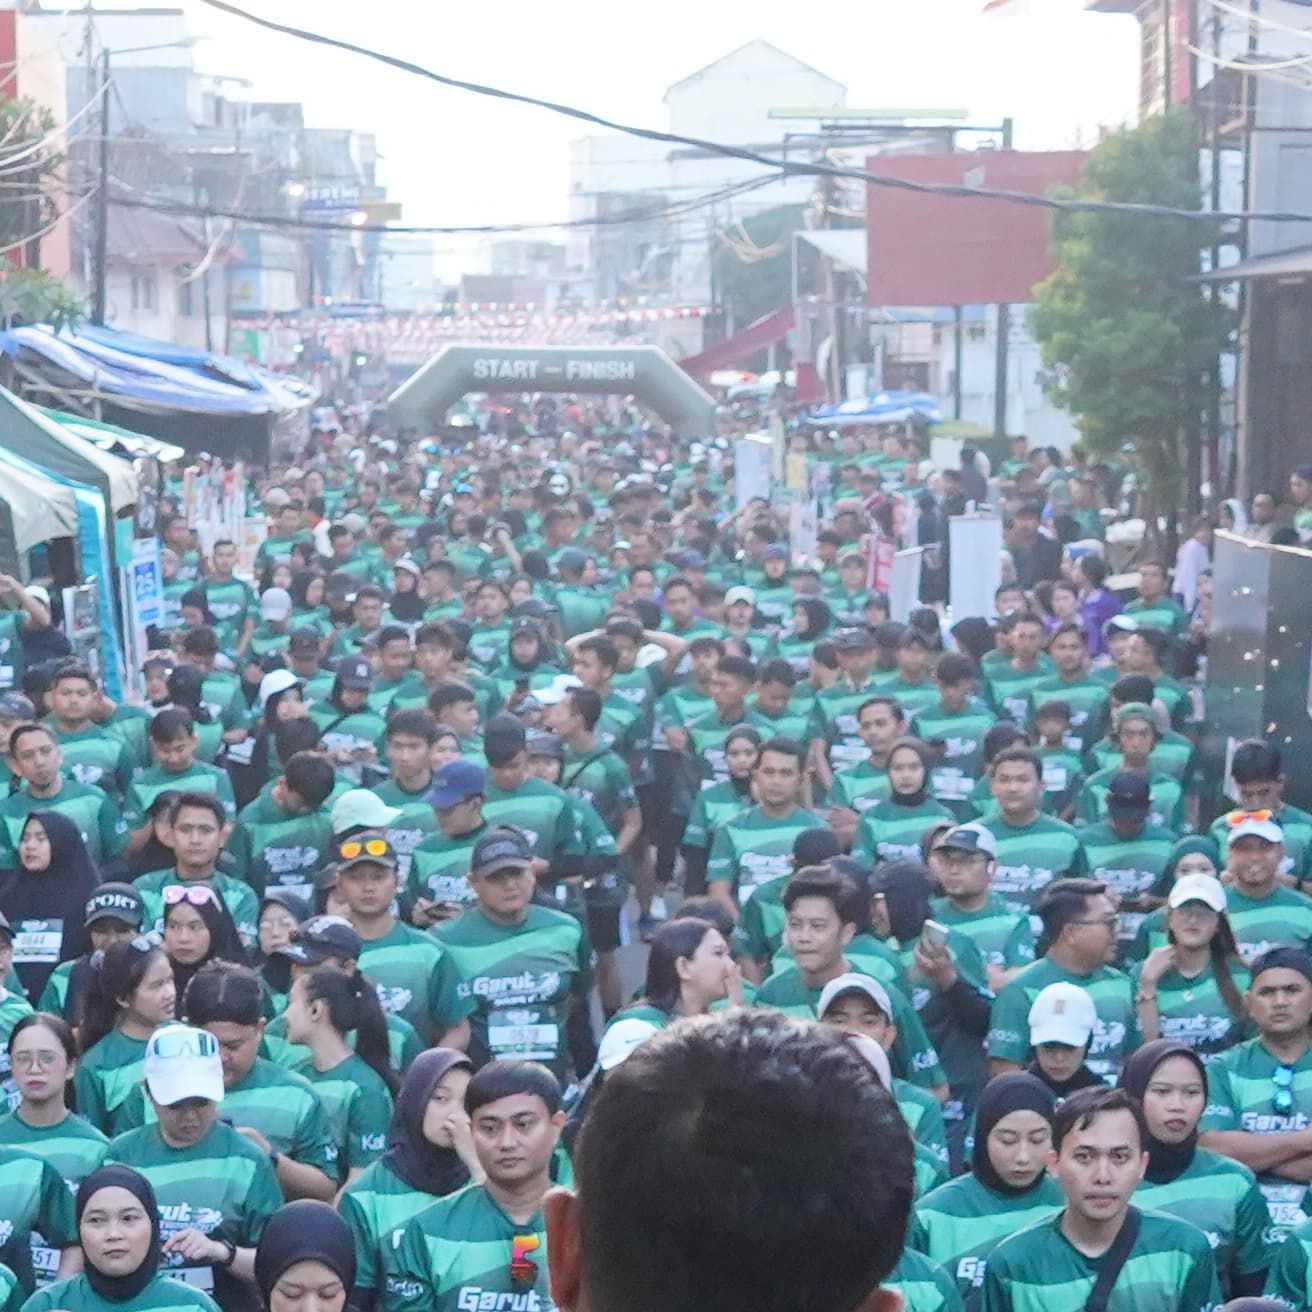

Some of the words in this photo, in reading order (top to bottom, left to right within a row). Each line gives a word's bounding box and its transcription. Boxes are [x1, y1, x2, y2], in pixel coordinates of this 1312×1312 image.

[473, 358, 539, 379] START
[565, 360, 635, 380] FINISH
[472, 972, 536, 994] Garut
[1241, 1110, 1311, 1133] Garut
[458, 1286, 542, 1312] Garut
